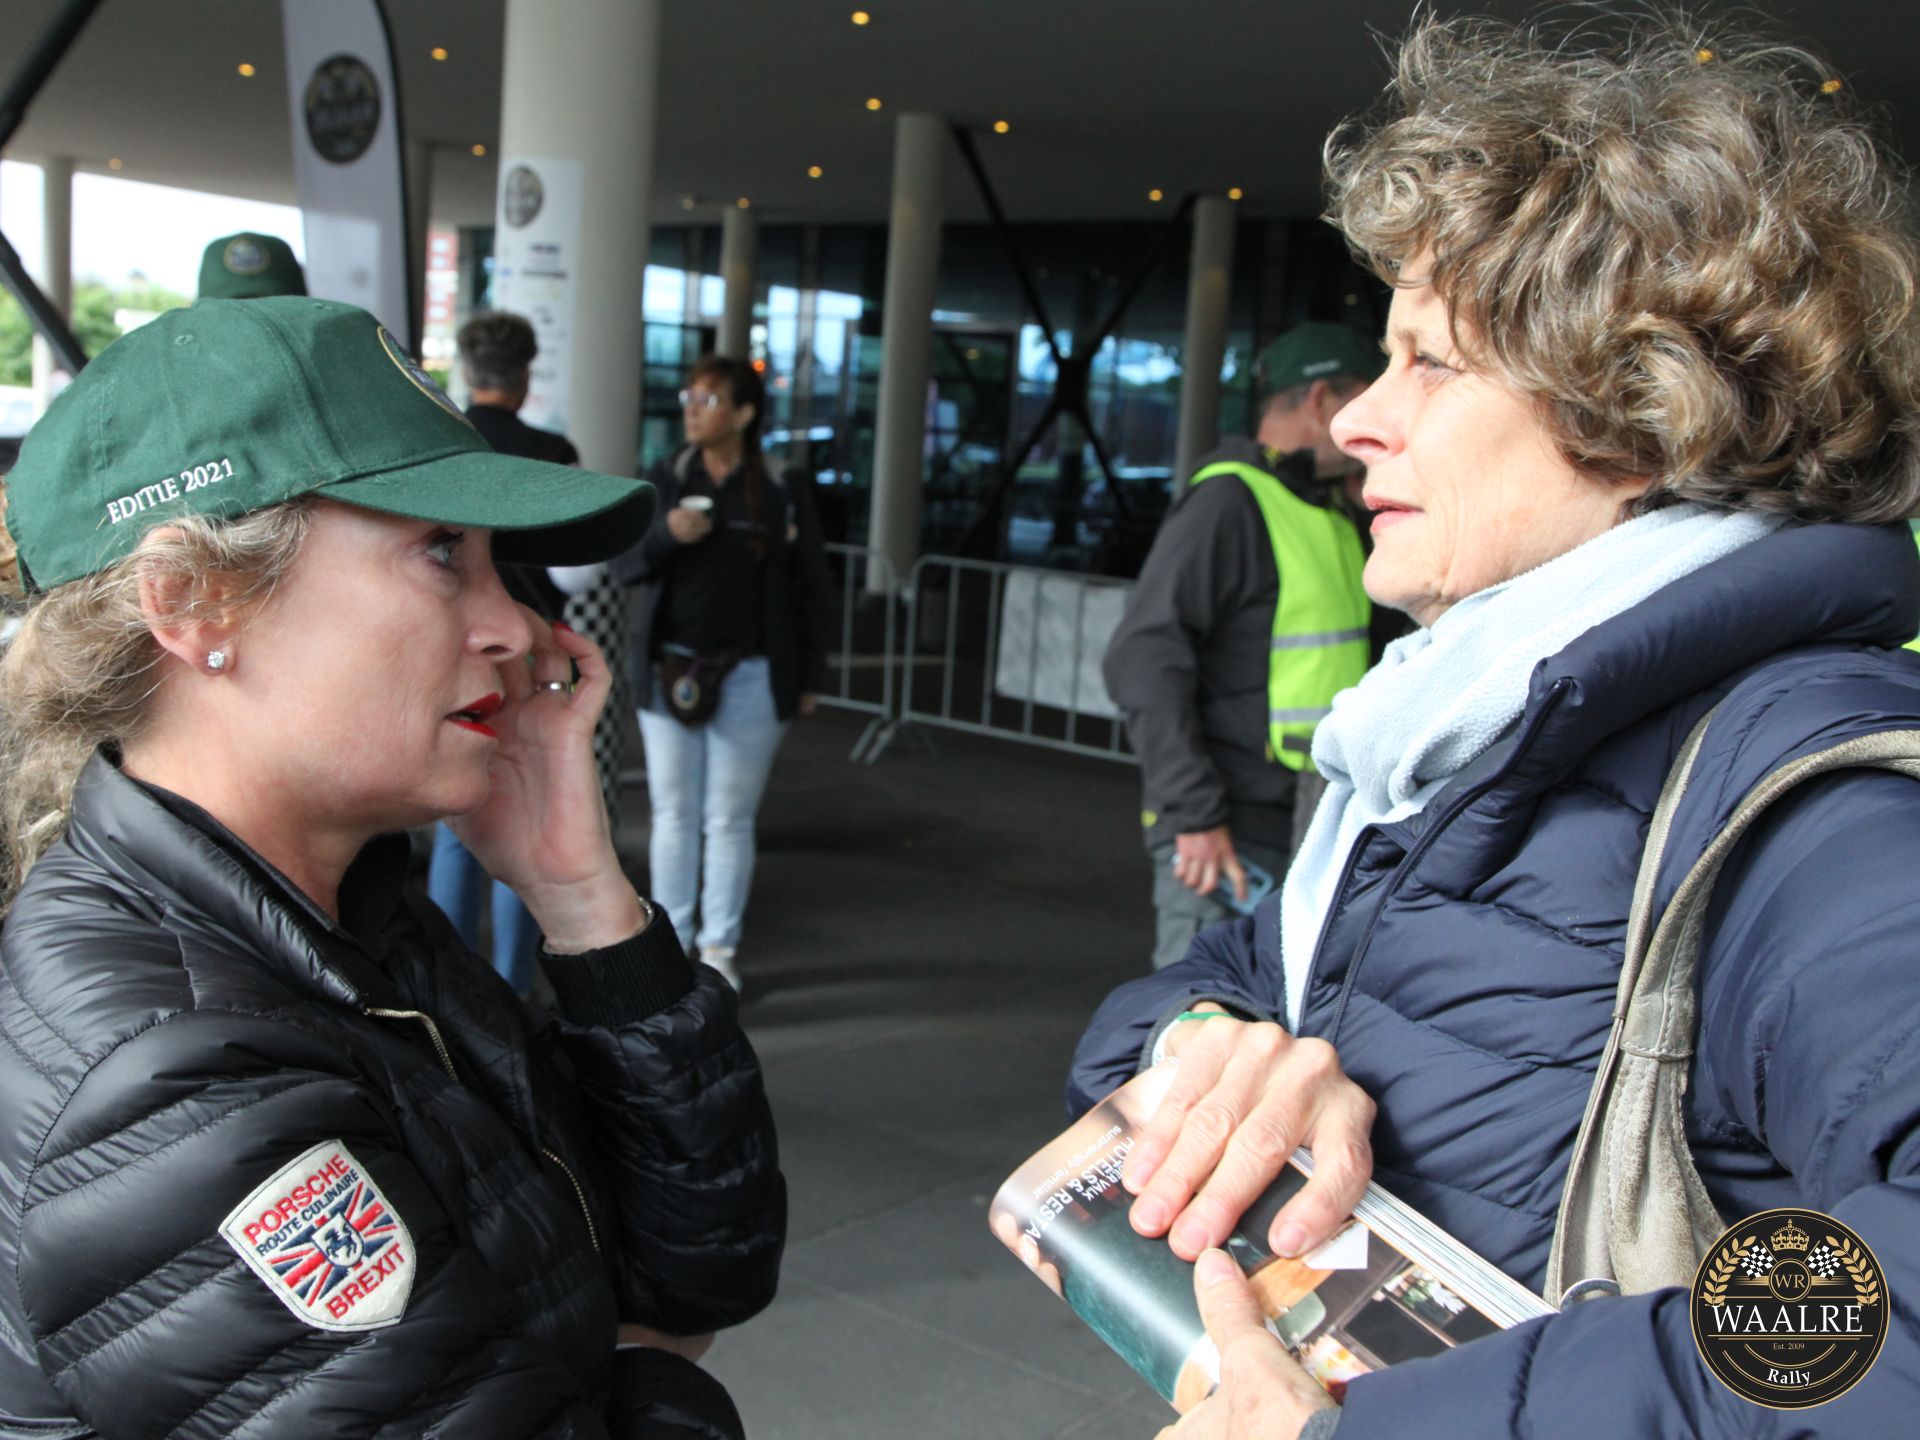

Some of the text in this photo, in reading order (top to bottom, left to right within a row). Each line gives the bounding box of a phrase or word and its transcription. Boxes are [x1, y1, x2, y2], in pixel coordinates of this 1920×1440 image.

[106, 458, 234, 524] EDITIE 2021
[242, 1154, 350, 1246] PORSCHE
[255, 1169, 360, 1257] ROUTE CULINAIRE
[1066, 1177, 1084, 1193] &
[1081, 1179, 1111, 1201] VALK
[325, 1243, 406, 1319] BREXIT
